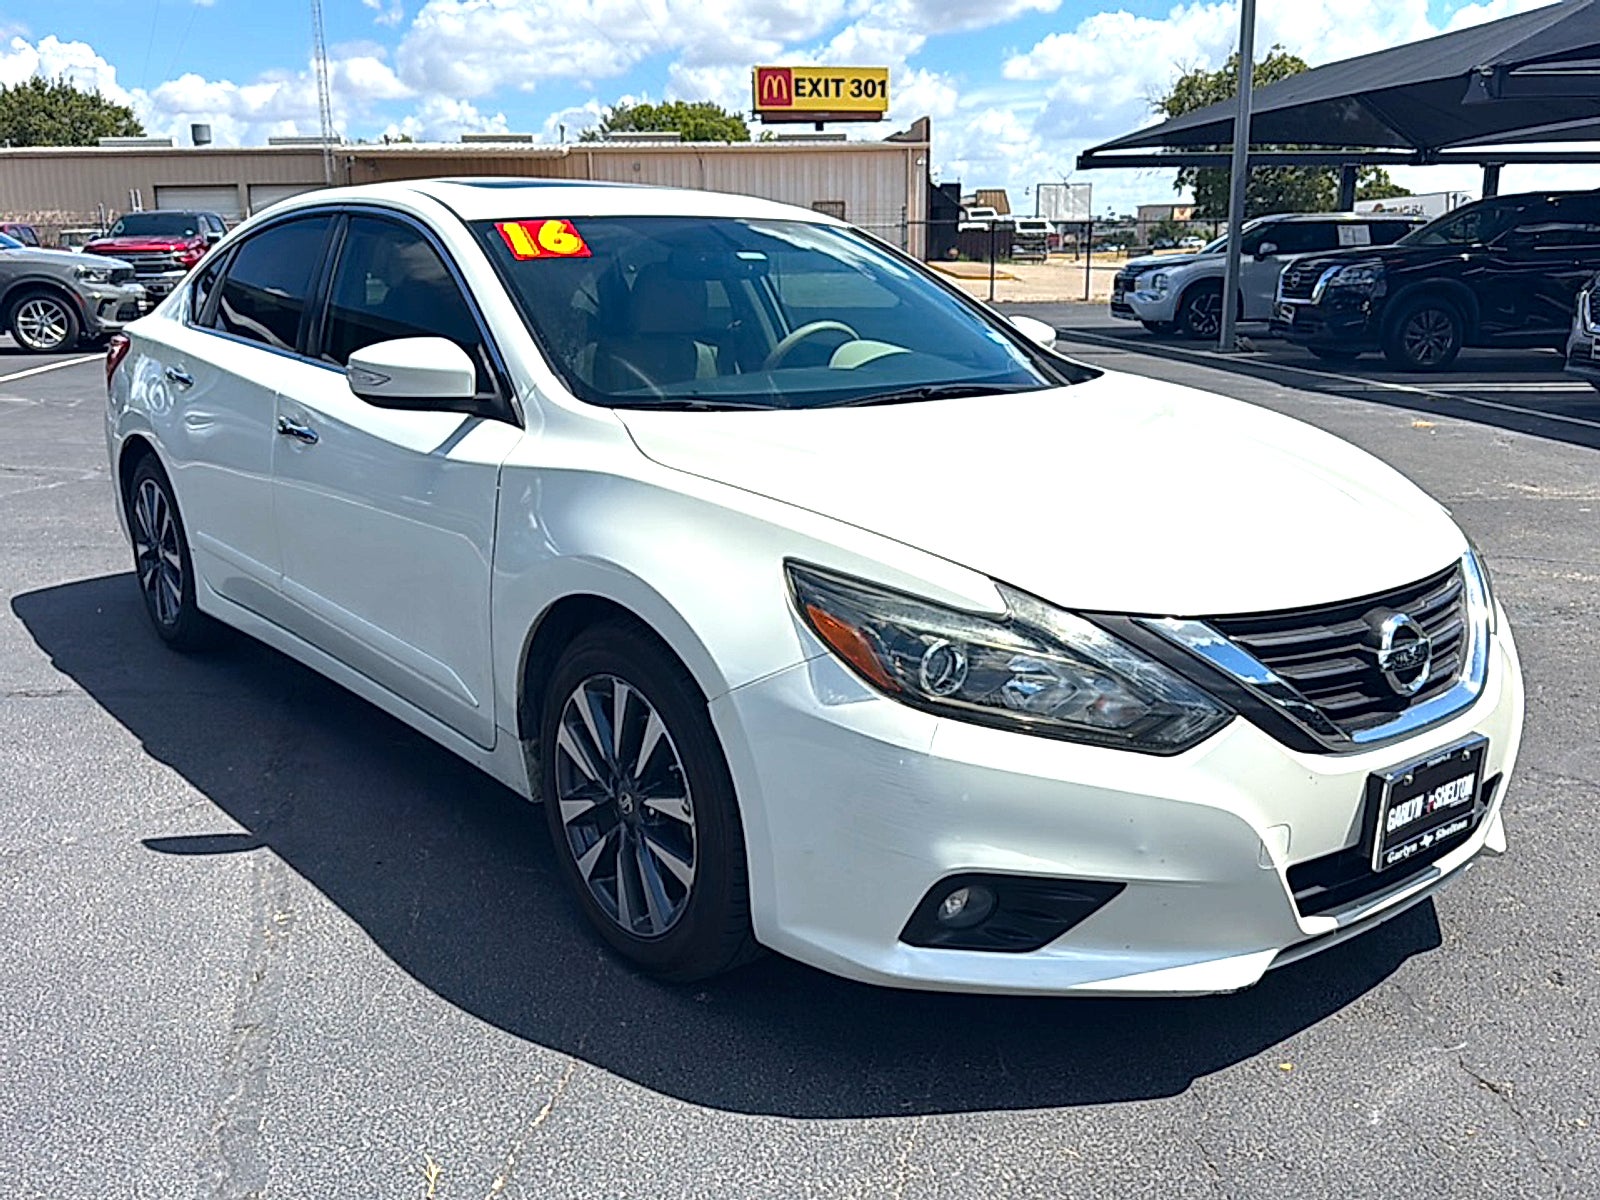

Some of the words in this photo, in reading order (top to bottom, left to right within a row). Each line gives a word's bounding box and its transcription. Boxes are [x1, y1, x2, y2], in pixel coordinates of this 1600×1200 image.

[794, 78, 845, 97] EXIT
[849, 79, 887, 98] 301
[503, 220, 583, 256] 16
[1433, 773, 1475, 810] SHELTON
